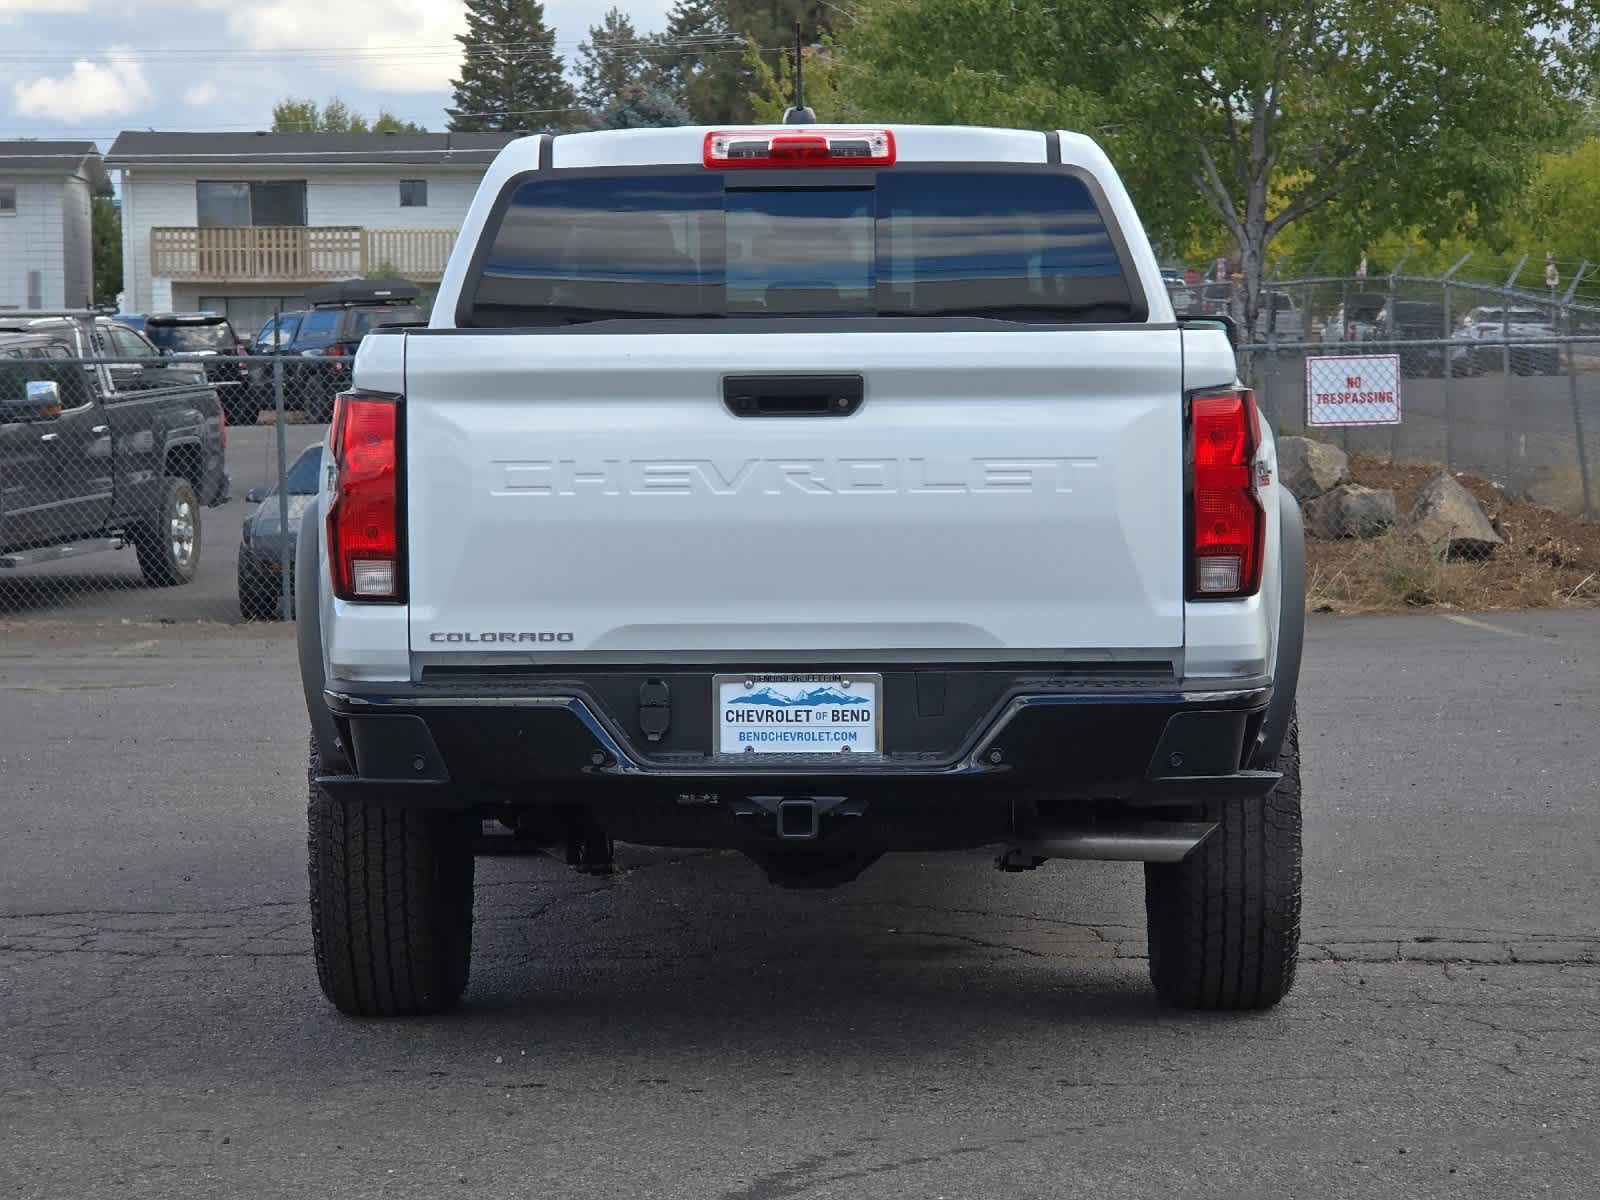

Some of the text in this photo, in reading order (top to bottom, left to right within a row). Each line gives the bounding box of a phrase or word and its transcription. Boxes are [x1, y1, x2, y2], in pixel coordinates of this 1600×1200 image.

[1345, 376, 1361, 389] NO
[1316, 391, 1393, 405] TRESPASSING
[489, 457, 1098, 496] CHEVROLET
[429, 632, 575, 643] COLORADO
[725, 709, 871, 723] CHEVROLET OF BEND
[738, 731, 858, 742] BENDCHEVROLET.COM
